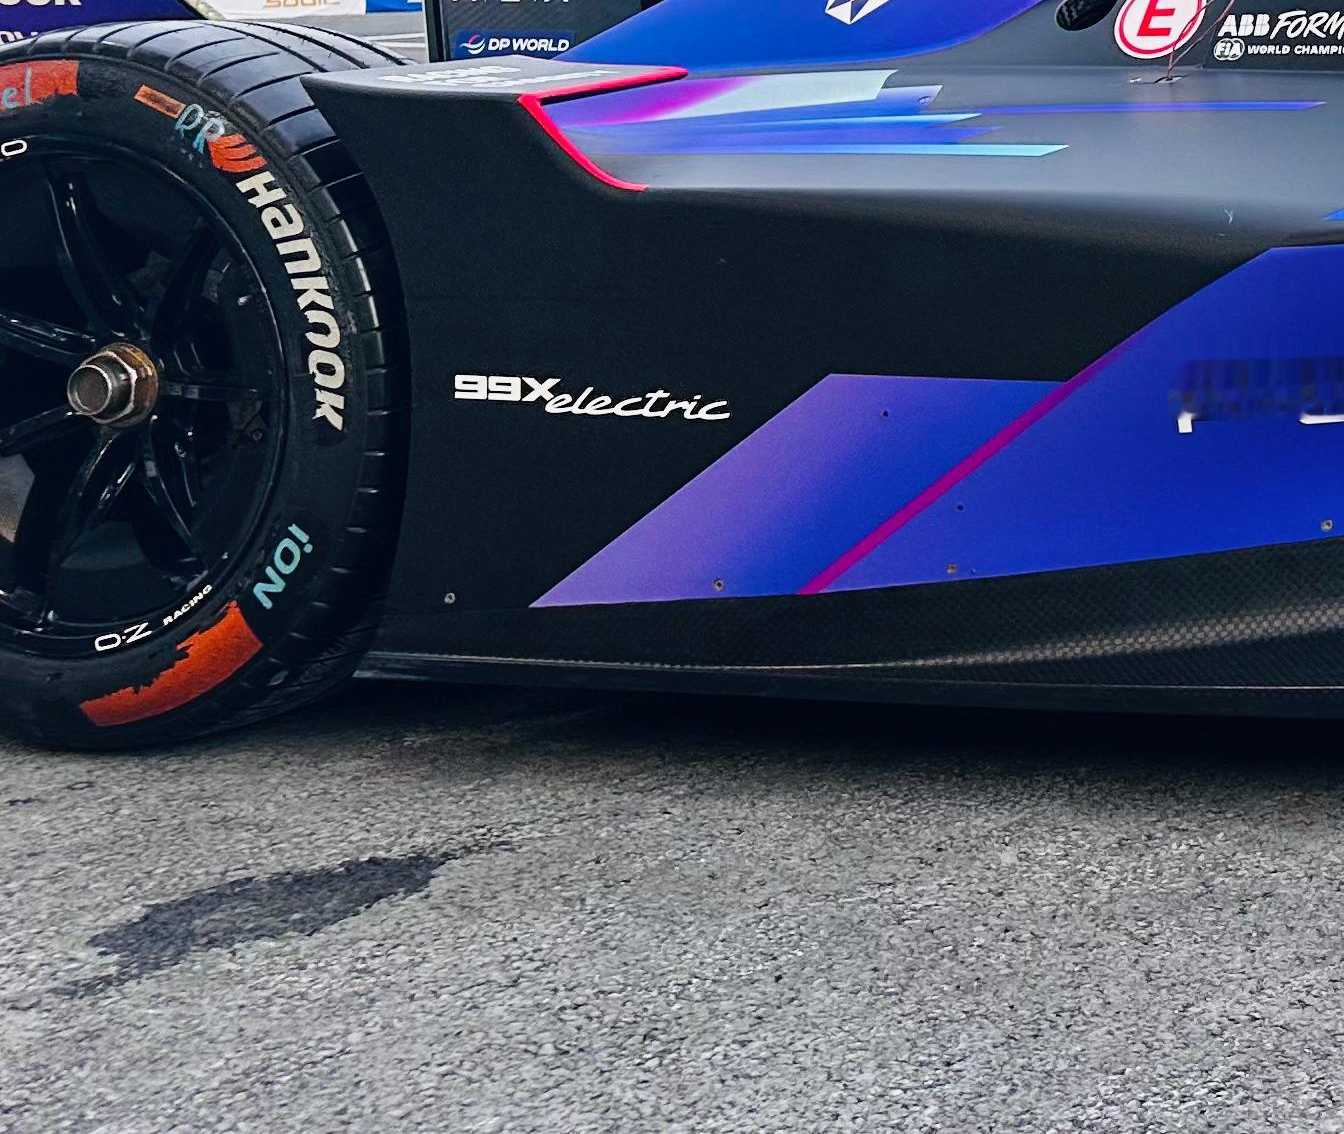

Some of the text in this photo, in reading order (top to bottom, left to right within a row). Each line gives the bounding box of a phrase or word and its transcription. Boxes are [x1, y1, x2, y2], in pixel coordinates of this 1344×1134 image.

[1217, 13, 1271, 38] ABB
[488, 38, 570, 52] DP WORLD
[1247, 44, 1291, 55] WORLD
[161, 583, 213, 628] RACING
